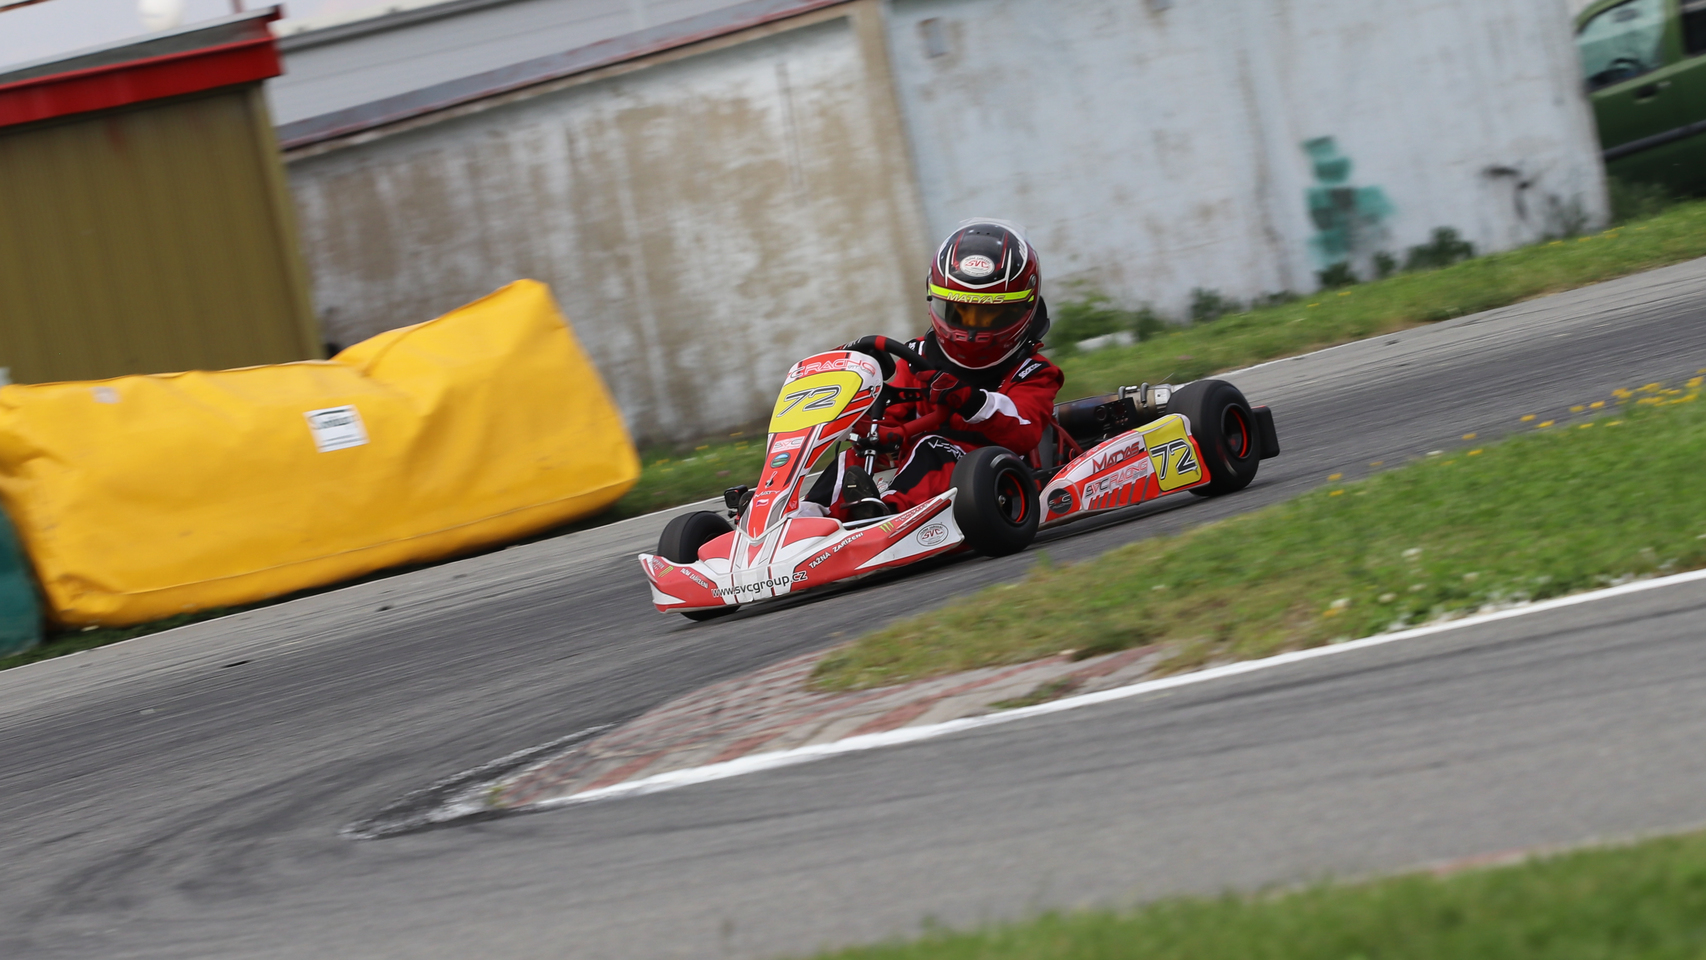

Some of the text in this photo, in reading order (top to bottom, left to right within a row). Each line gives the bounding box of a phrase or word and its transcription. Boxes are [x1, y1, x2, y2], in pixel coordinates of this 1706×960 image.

[965, 259, 990, 269] SVC
[946, 292, 1006, 304] MATYAS
[775, 384, 842, 418] 72
[1092, 441, 1140, 475] MATYAS
[1149, 437, 1198, 480] 72
[921, 528, 943, 540] SVC
[711, 570, 809, 599] www.svcgroup.cz
